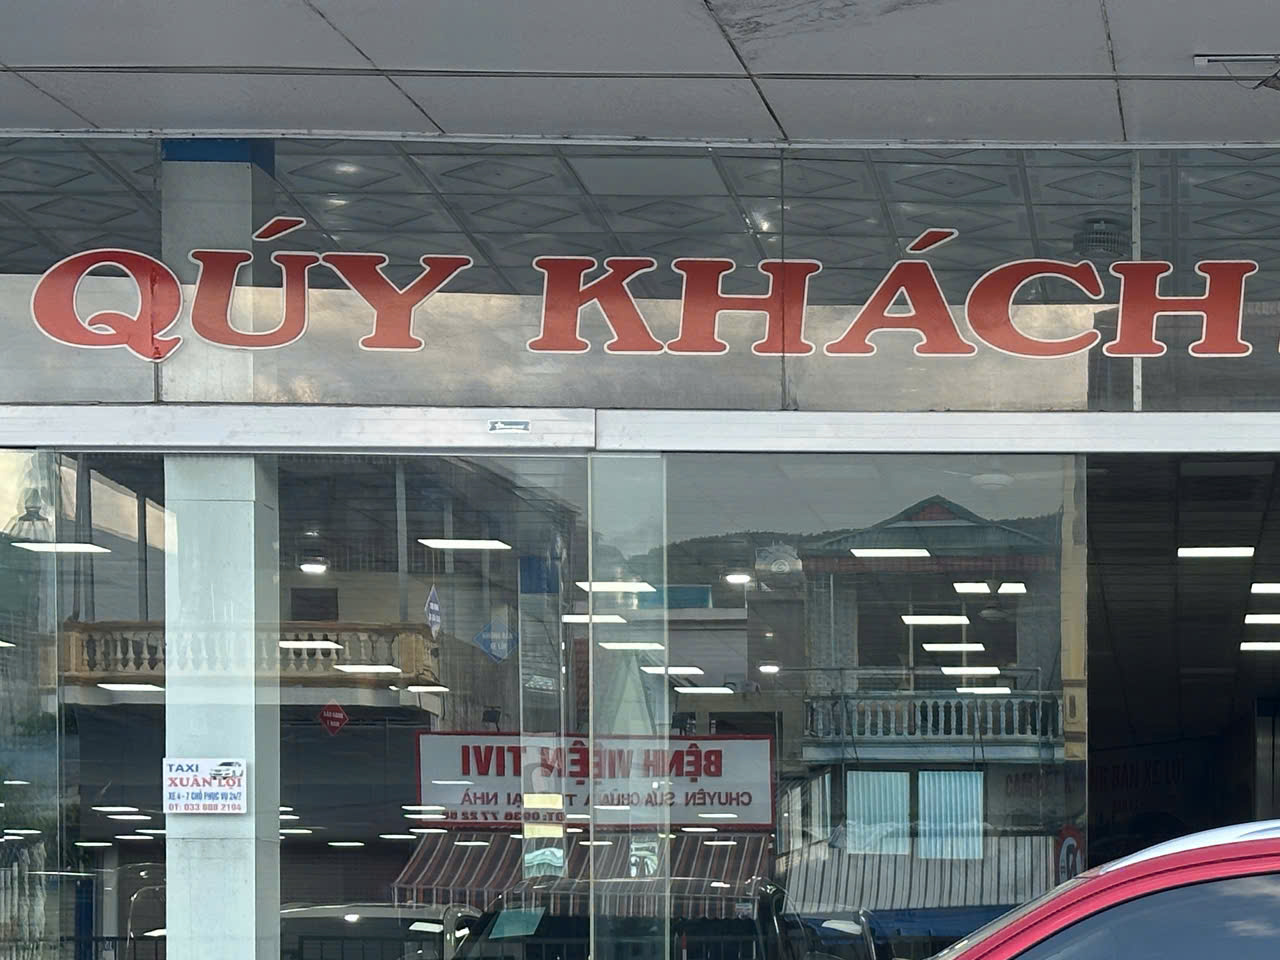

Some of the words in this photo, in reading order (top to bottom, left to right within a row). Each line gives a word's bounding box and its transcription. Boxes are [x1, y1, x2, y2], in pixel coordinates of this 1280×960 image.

[32, 216, 473, 362] QÚY
[168, 763, 199, 773] TAXI
[168, 774, 213, 788] XUÂN
